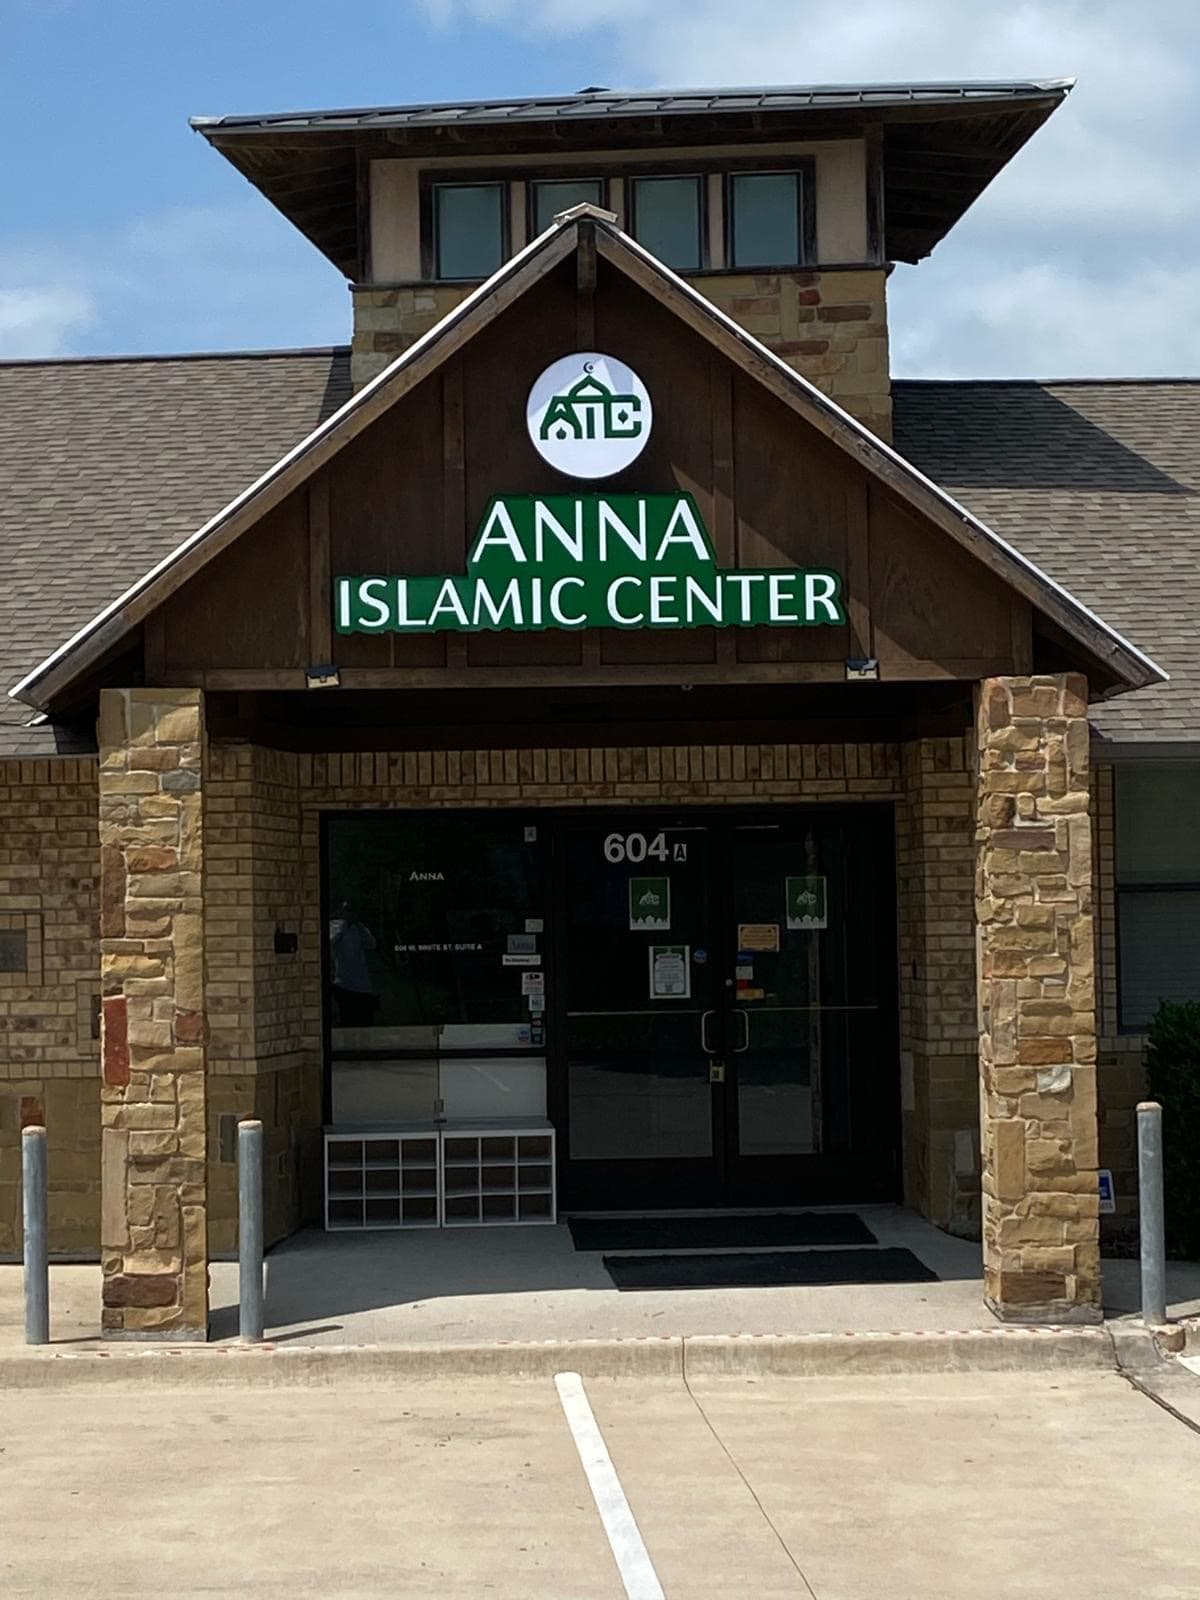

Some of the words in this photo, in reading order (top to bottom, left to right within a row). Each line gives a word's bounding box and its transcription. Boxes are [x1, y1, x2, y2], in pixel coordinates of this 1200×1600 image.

[472, 499, 710, 562] ANNA
[340, 577, 587, 627] ISLAMIC
[606, 574, 840, 624] CENTER
[604, 832, 669, 863] 604
[674, 843, 687, 861] A
[409, 871, 445, 881] ANNA
